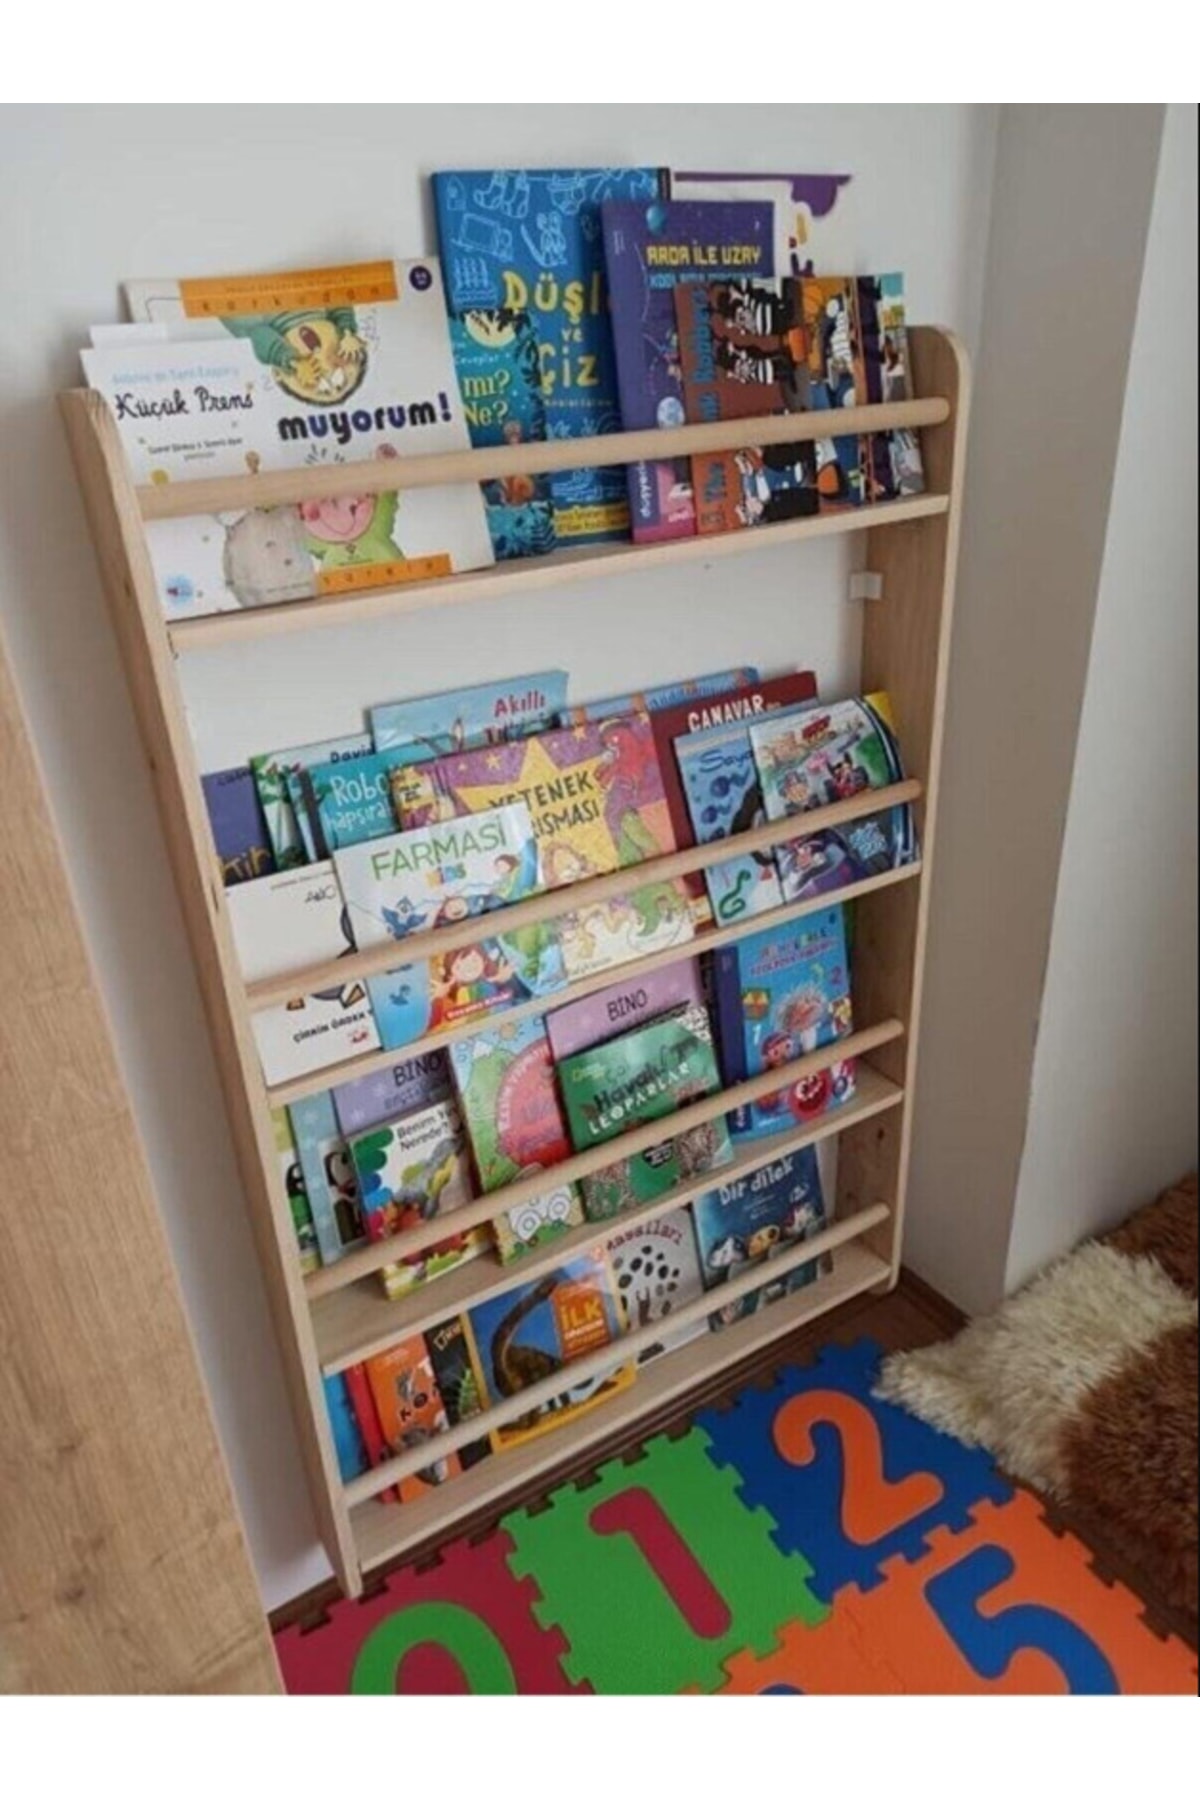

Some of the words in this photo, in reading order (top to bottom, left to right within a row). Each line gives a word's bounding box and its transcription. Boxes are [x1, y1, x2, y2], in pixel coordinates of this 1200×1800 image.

[114, 387, 190, 421] Küçük
[194, 384, 254, 413] Prens
[278, 391, 452, 445] muyorum!
[687, 694, 765, 731] CANAVAR
[773, 1390, 944, 1545] 2
[588, 1486, 732, 1641] 1
[923, 1543, 1121, 1696] 5
